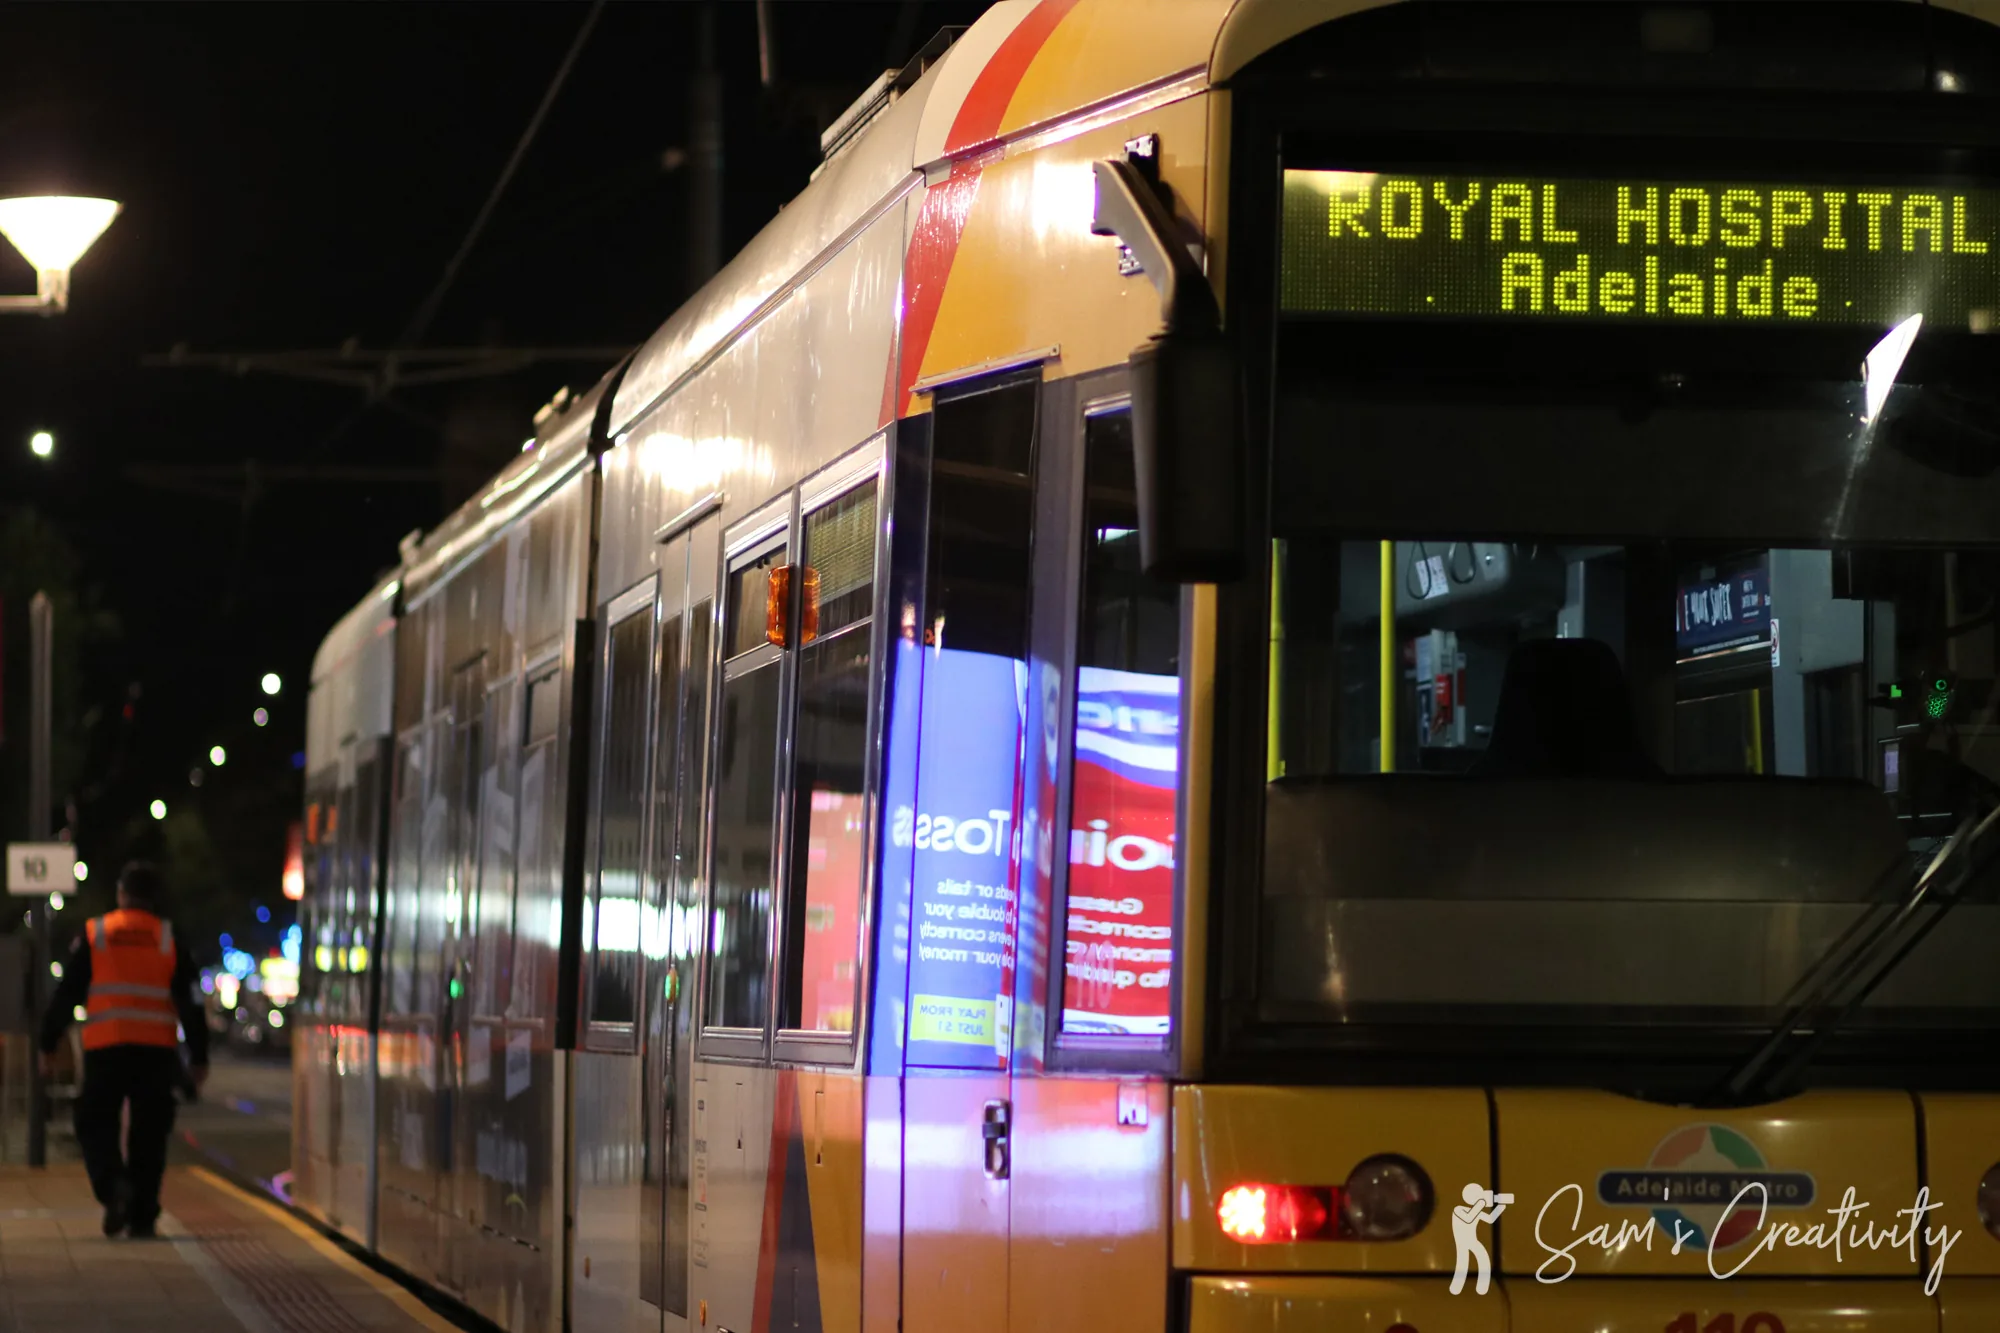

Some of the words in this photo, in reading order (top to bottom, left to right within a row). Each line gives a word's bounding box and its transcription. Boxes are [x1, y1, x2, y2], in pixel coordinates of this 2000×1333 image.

[1328, 179, 1580, 243] ROYAL
[1616, 185, 1989, 254] HOSPITAL
[1501, 251, 1819, 318] Adelaide
[1617, 1177, 1722, 1197] Adelaide
